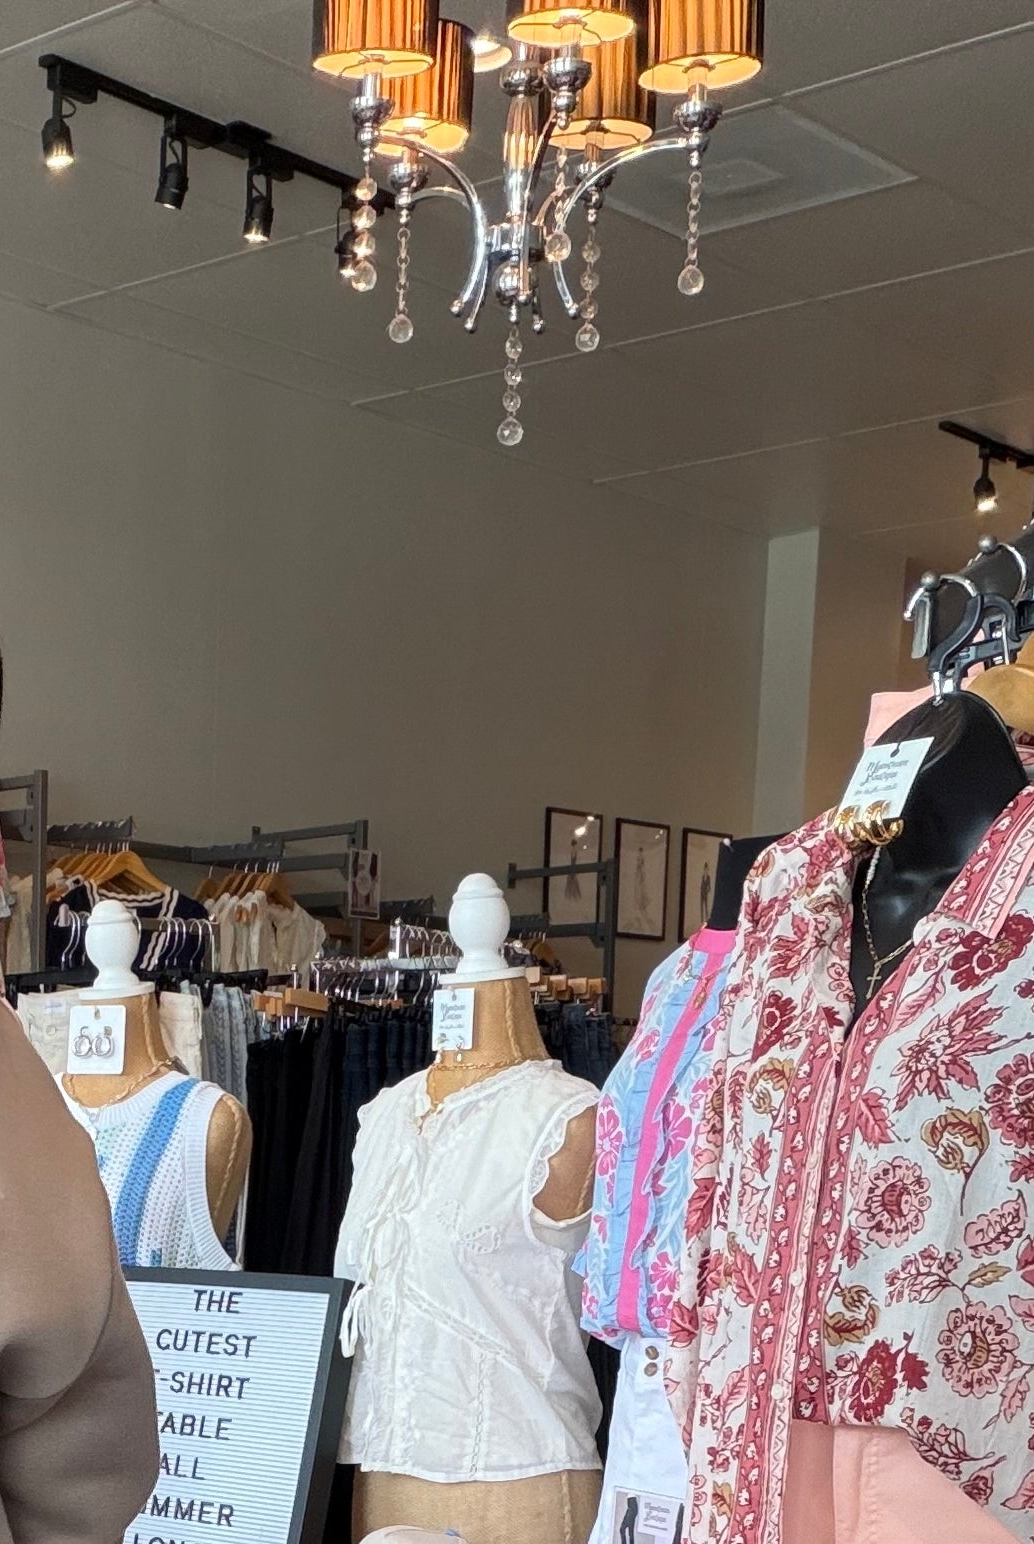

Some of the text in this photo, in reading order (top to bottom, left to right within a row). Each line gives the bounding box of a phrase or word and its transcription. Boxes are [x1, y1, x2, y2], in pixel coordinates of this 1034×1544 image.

[193, 1289, 243, 1314] THE
[156, 1328, 257, 1358] CUTEST
[154, 1369, 251, 1400] -SHIRT
[158, 1411, 233, 1441] ABLE
[160, 1452, 206, 1481] ALL
